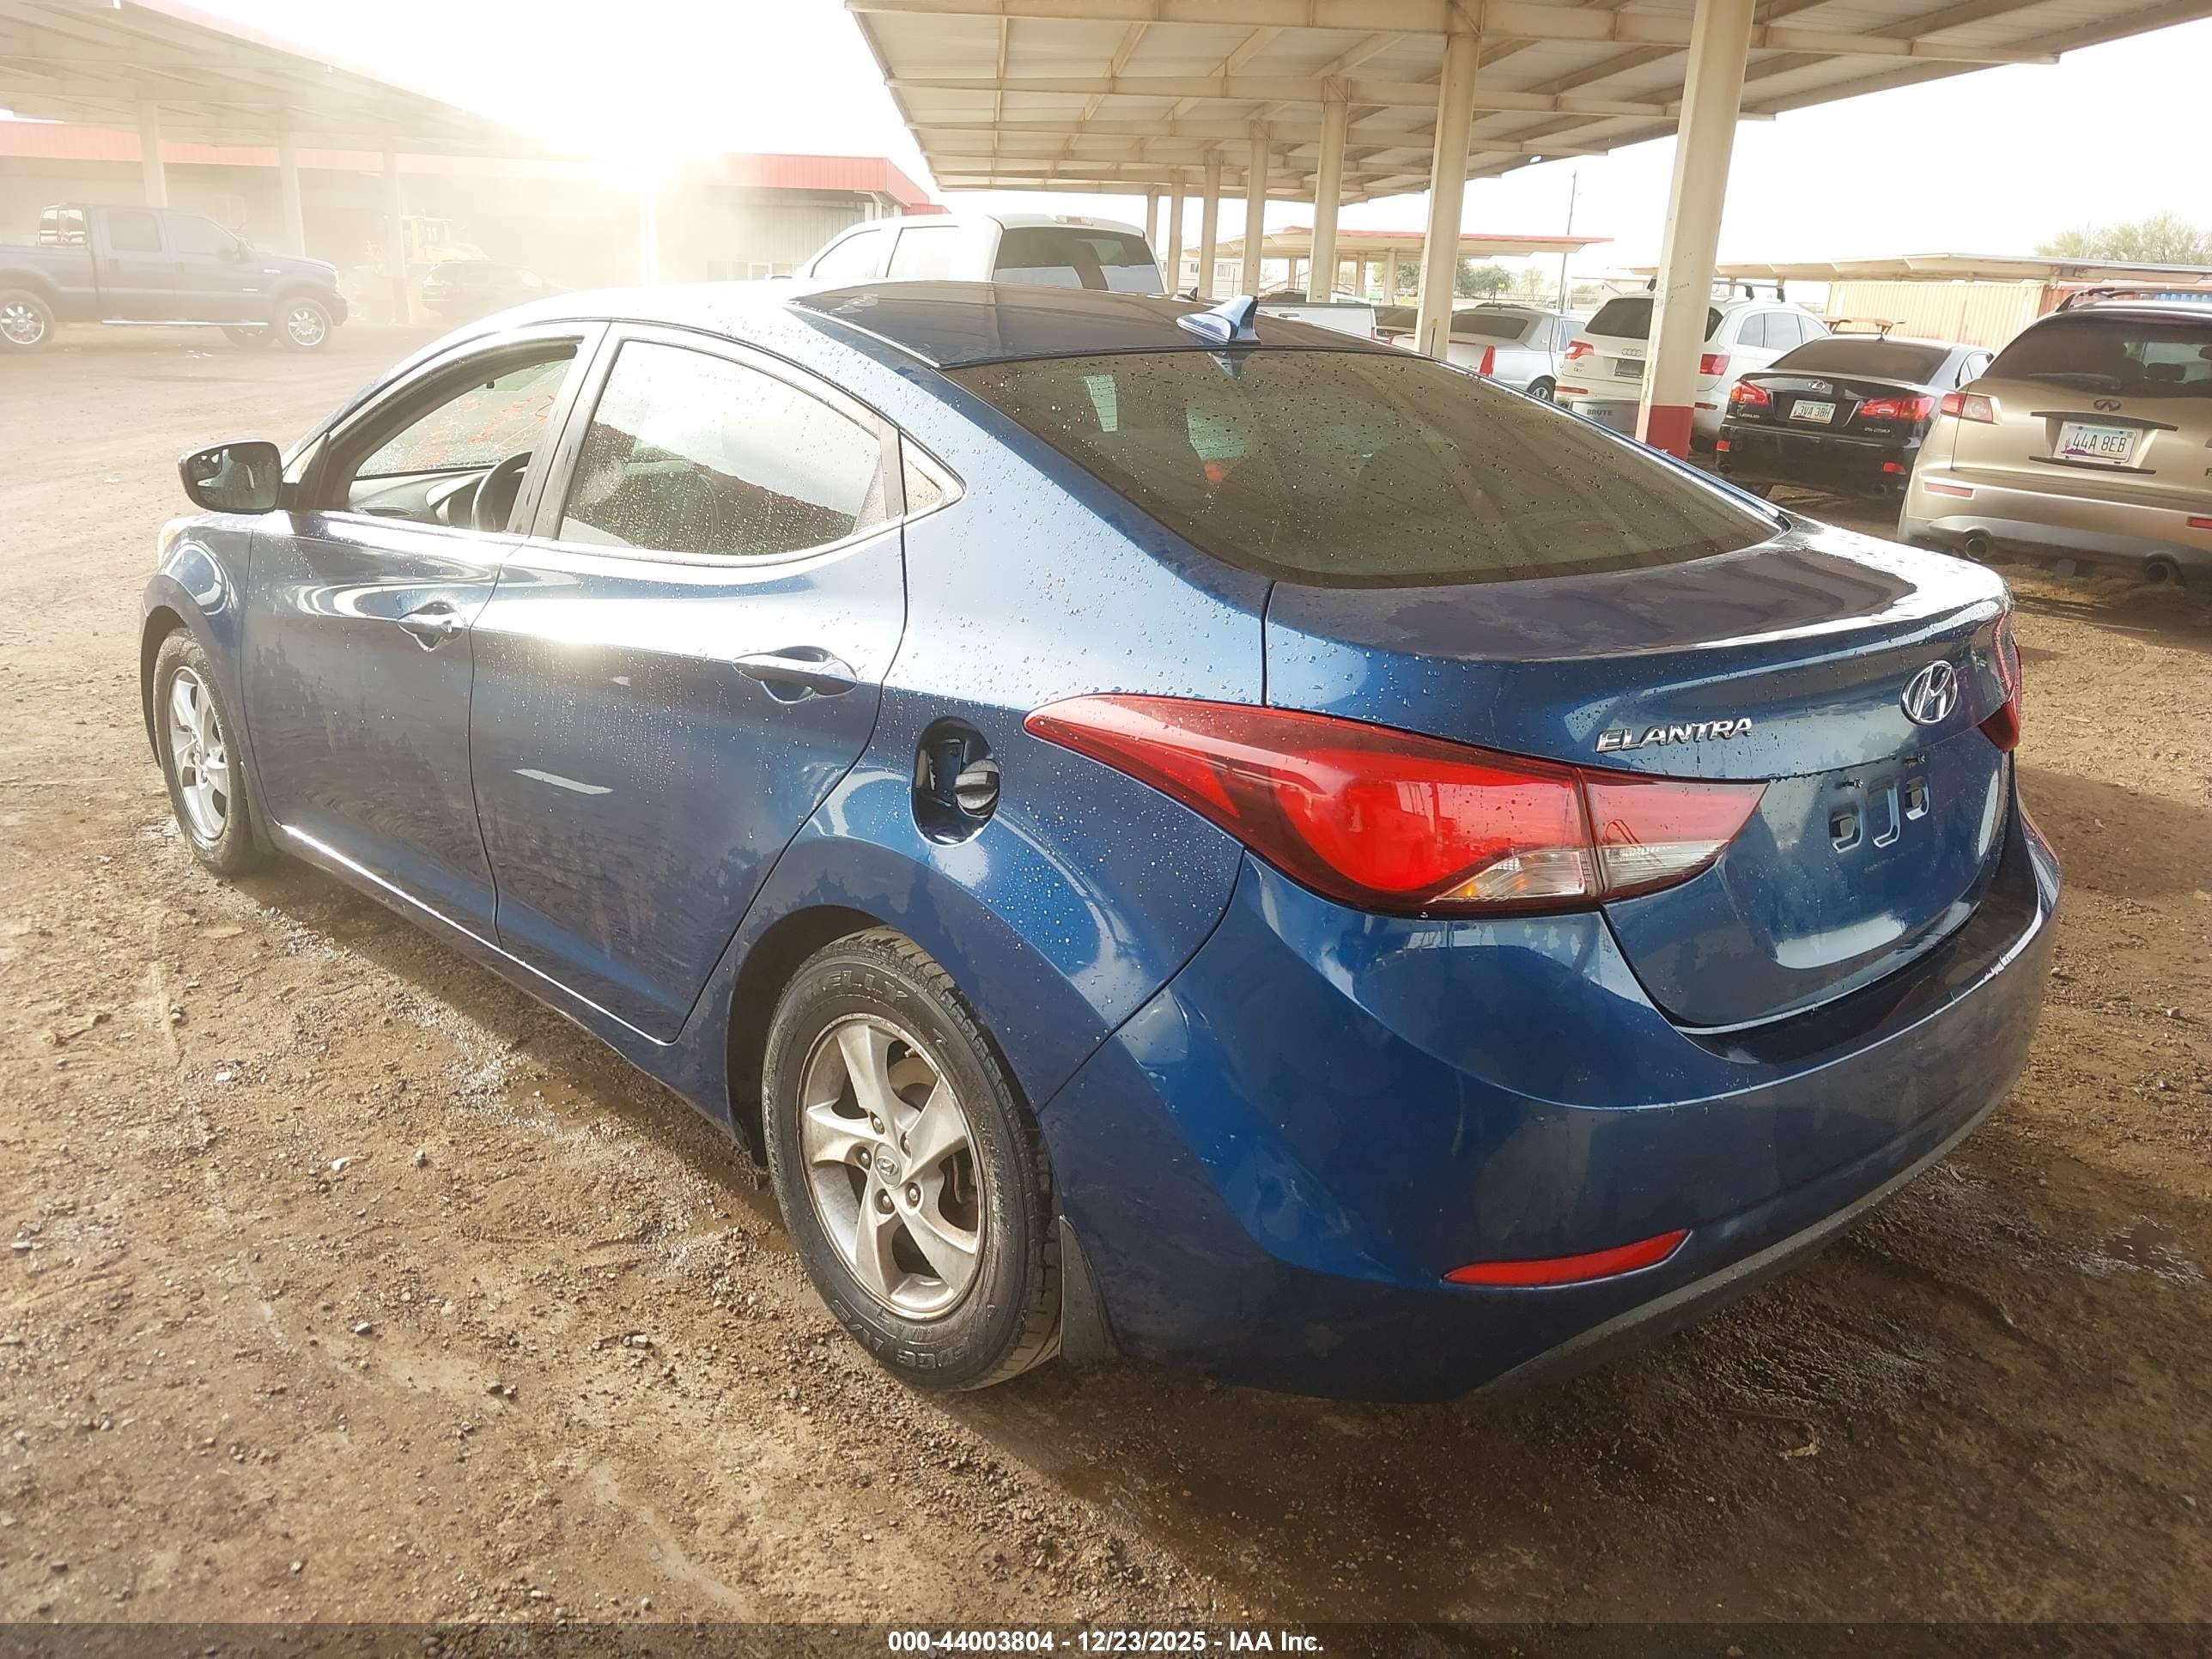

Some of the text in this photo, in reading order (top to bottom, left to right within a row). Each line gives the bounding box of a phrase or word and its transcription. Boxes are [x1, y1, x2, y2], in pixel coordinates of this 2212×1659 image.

[1586, 408, 1614, 416] BRUTE
[2072, 432, 2127, 453] 44A 8EB
[1595, 716, 1753, 753] ELANTRA
